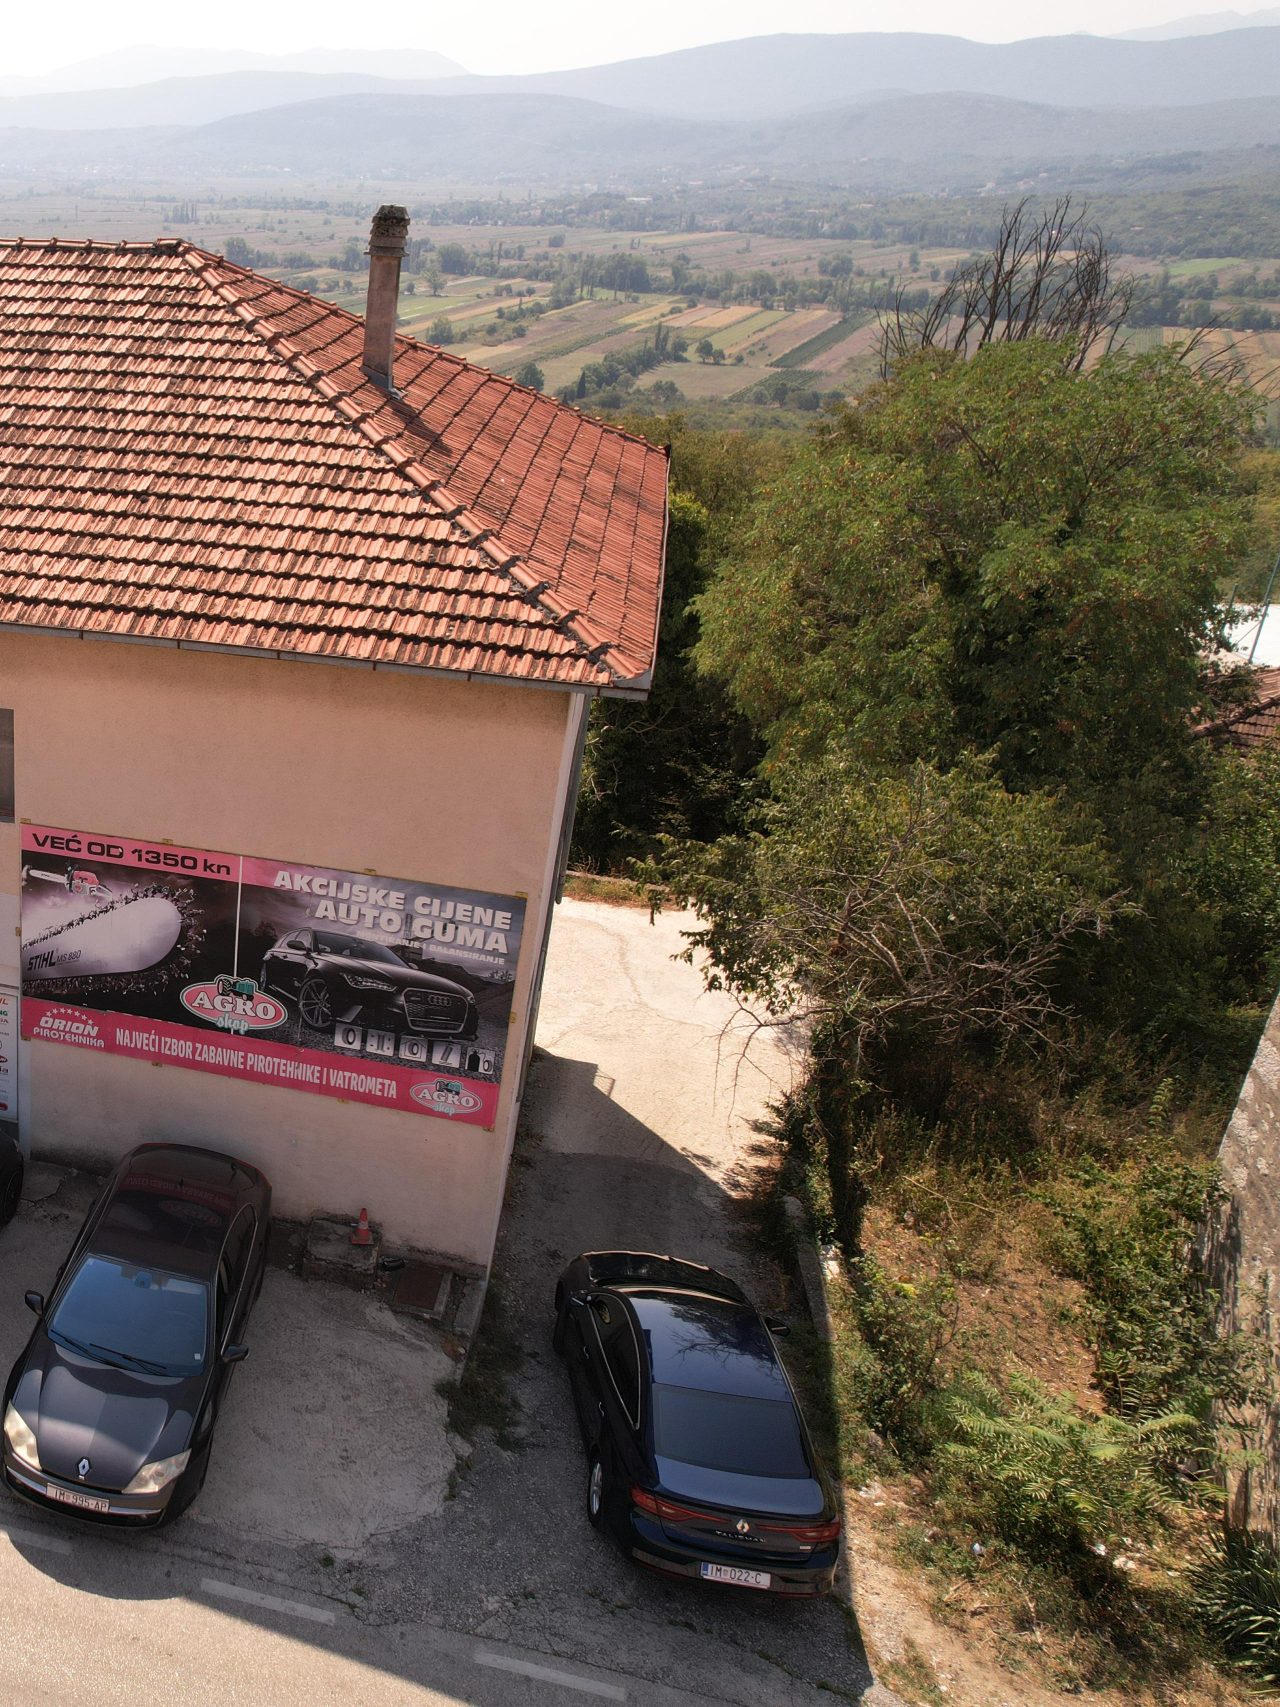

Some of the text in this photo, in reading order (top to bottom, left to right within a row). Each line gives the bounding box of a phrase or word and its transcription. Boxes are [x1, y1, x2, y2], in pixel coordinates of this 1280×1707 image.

[32, 833, 231, 875] VEĆ OD 1350 kn
[273, 870, 512, 930] AKCIJSKE CIJENE
[314, 899, 509, 954] AUTO GUMA
[27, 950, 56, 971] STIHL
[191, 991, 276, 1020] AGRO
[39, 1016, 100, 1036] ORION
[216, 1013, 250, 1035] shop
[33, 1027, 105, 1048] PIROTEHNIKA
[116, 1028, 397, 1099] NAJVEĆI IZBOR ZABAVNE PIROTEHNIKE I VATROMETA
[417, 1088, 475, 1107] AGRO
[55, 1489, 106, 1510] IM 995-AP
[711, 1566, 761, 1584] IM 022-C
